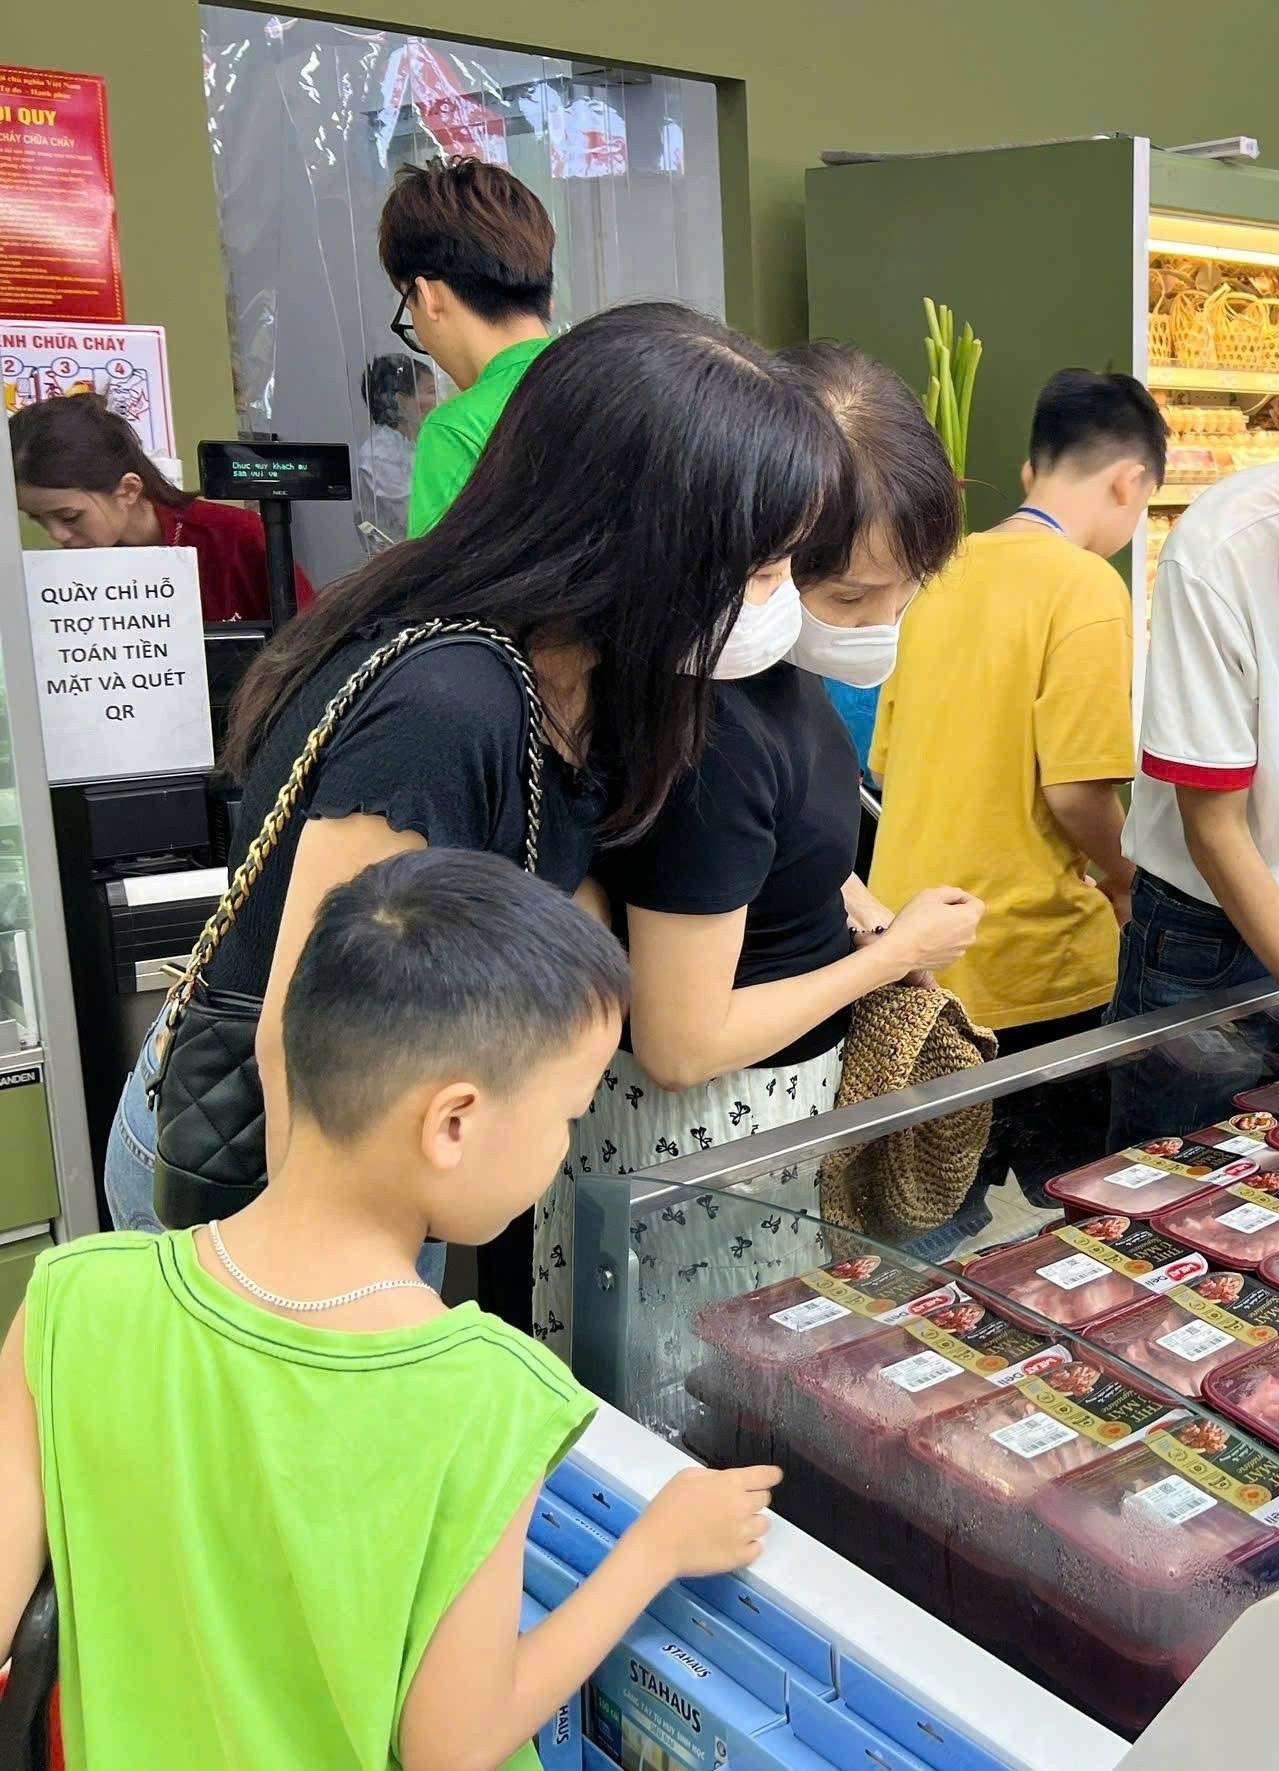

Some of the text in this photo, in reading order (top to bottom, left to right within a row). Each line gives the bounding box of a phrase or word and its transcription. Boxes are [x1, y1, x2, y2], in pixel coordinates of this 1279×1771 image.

[17, 107, 57, 127] QUY
[33, 332, 78, 350] CHỮA
[83, 336, 126, 351] CHÁY
[4, 360, 15, 372] 2
[60, 361, 71, 374] 3
[115, 363, 125, 375] 4
[41, 577, 175, 604] QUẦY CHỈ HỖ
[50, 613, 171, 635] TRỢ THANH
[58, 639, 168, 664] TOÁN TIỀN
[47, 668, 186, 696] MẶT VÀ QUÉT
[105, 705, 135, 721] QR
[662, 1644, 711, 1678] STAHAUS
[629, 1659, 702, 1733] STAHAUS
[556, 1704, 569, 1745] HAUS
